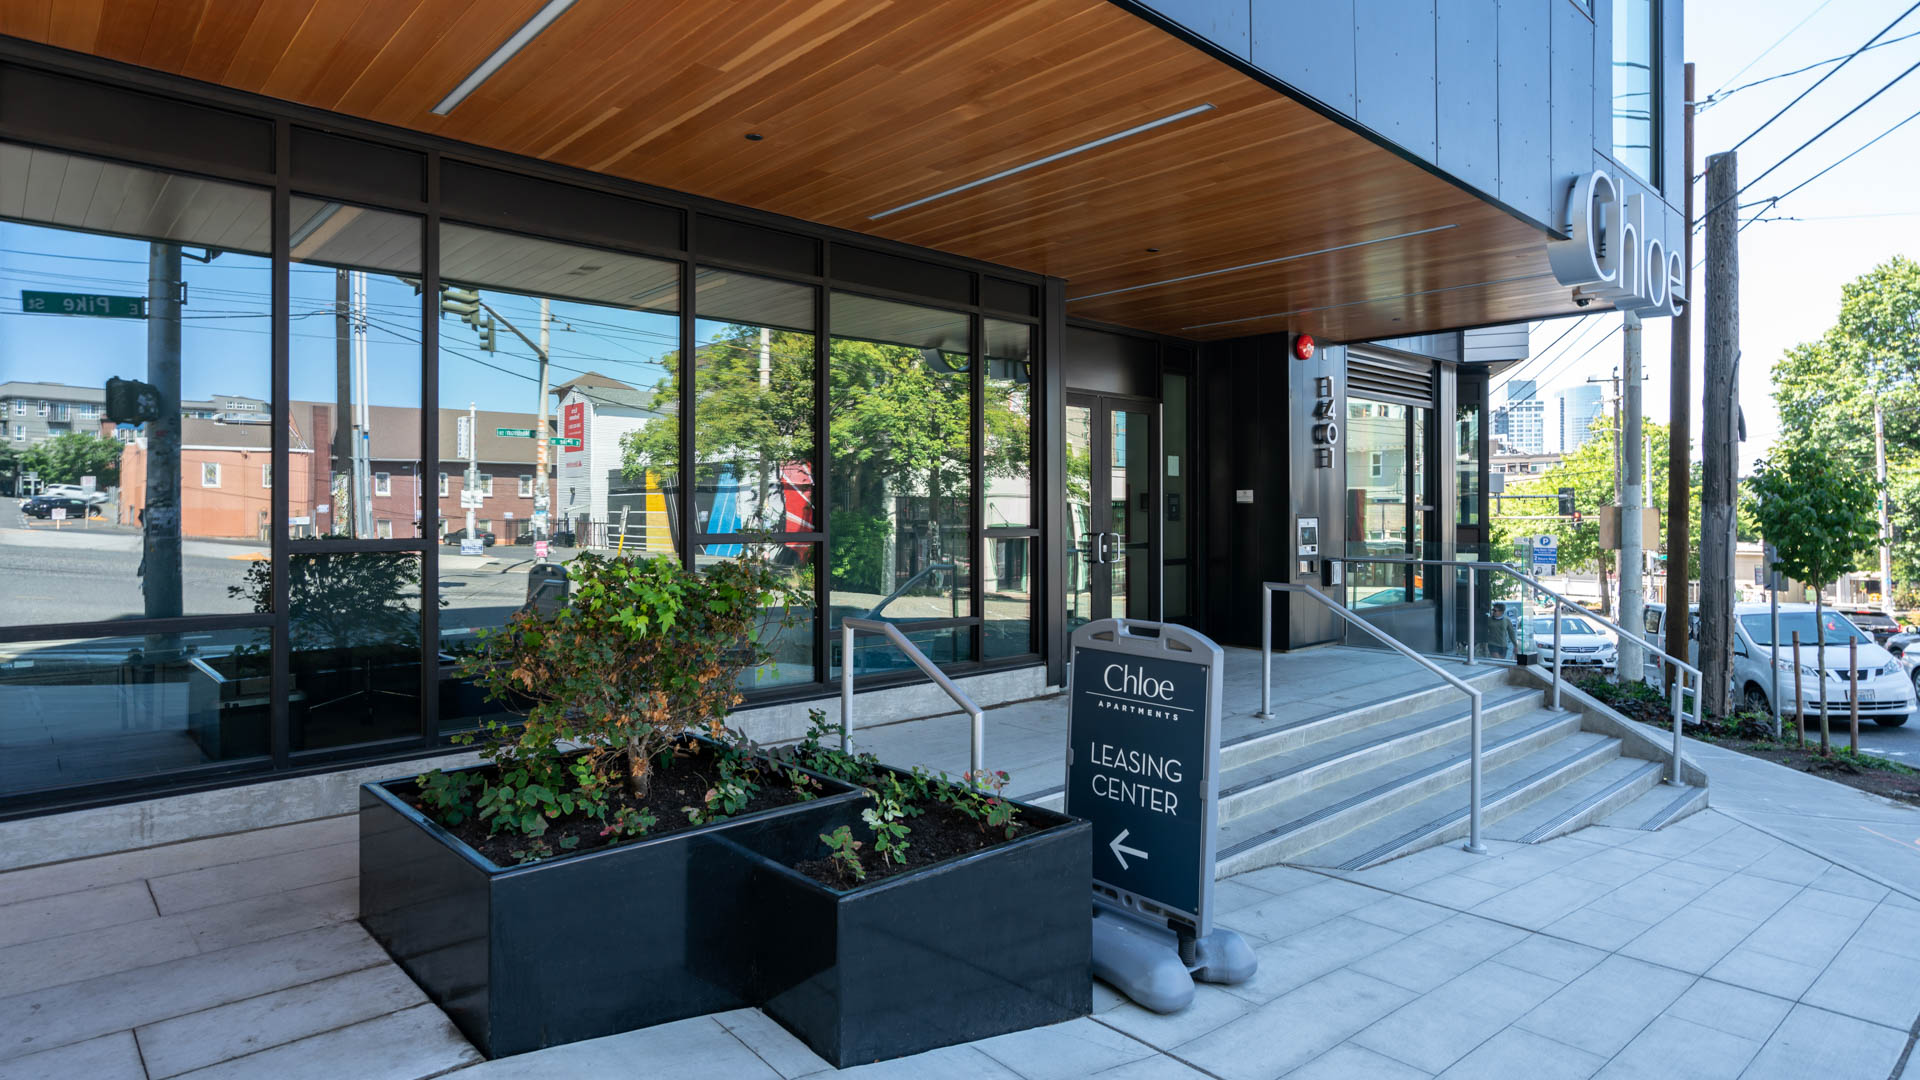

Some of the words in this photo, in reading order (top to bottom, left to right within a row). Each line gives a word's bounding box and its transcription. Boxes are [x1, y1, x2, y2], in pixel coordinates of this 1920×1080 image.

[1583, 169, 1683, 317] Chloe
[1103, 663, 1175, 701] Chloe
[1098, 700, 1179, 721] APARTMENTS
[1091, 741, 1183, 783] LEASING
[1092, 774, 1178, 816] CENTER
